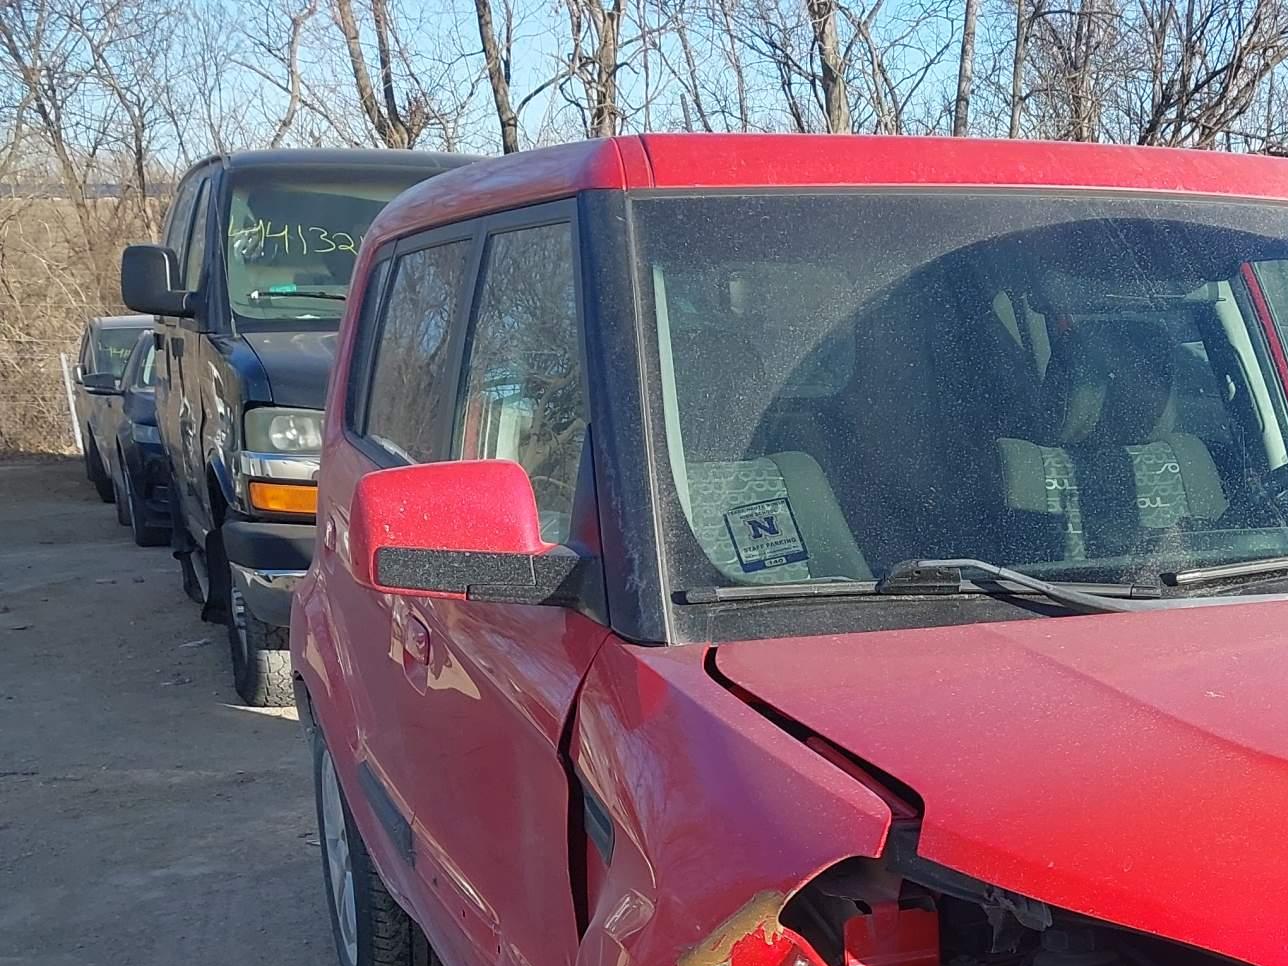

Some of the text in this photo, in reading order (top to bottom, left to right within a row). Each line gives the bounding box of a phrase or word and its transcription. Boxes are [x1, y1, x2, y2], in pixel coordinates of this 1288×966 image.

[227, 215, 364, 256] 44132
[746, 515, 780, 539] N
[743, 543, 765, 553] STAFF
[766, 537, 797, 547] PARKING
